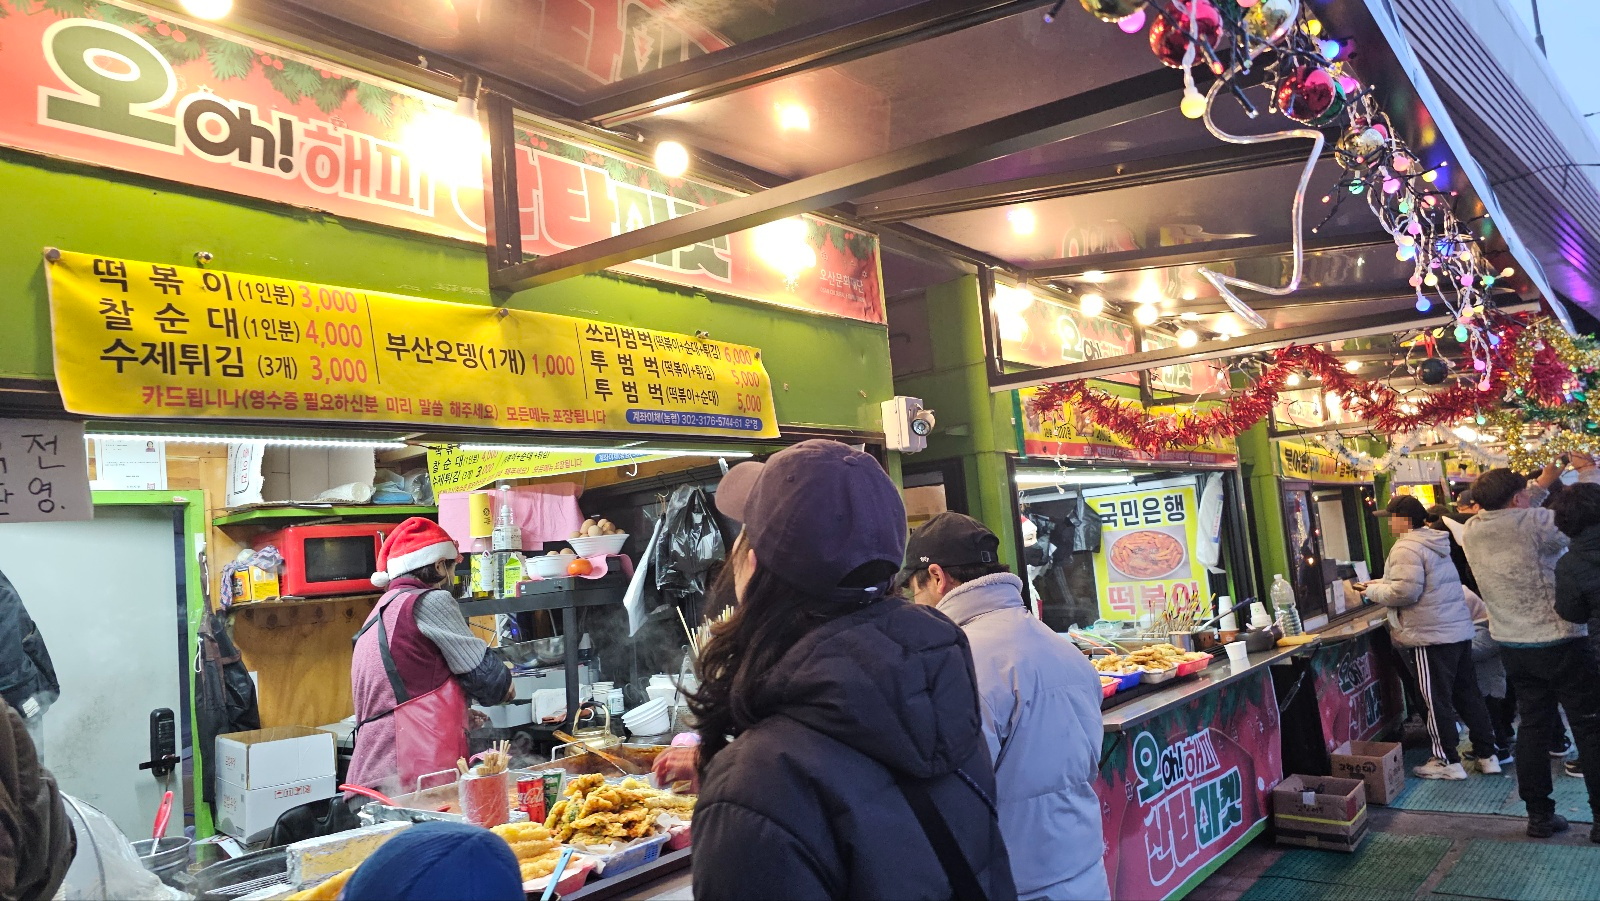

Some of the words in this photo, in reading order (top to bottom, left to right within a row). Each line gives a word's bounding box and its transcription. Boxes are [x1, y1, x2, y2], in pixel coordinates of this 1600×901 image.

[298, 285, 357, 313] 3,000
[305, 320, 362, 348] 4,000
[100, 338, 244, 377] 수제튀김
[257, 354, 298, 380] (3개)
[309, 355, 367, 385] 3,000
[532, 353, 575, 378] 1,000
[724, 347, 752, 365] 6,000
[731, 370, 760, 387] 5,000
[303, 392, 378, 413] 필요하신분
[386, 397, 412, 414] 미리
[419, 399, 443, 416] 말씀
[449, 401, 499, 420] 해주세요)
[506, 407, 550, 422] 모든메뉴
[553, 409, 606, 424] 포장됩니다
[737, 393, 762, 412] 5,000
[681, 415, 742, 428] 302-3176-5744-61
[1099, 494, 1185, 528] 국민은행
[1108, 581, 1200, 616] 떡볶이
[1144, 766, 1242, 886] 산타마켓
